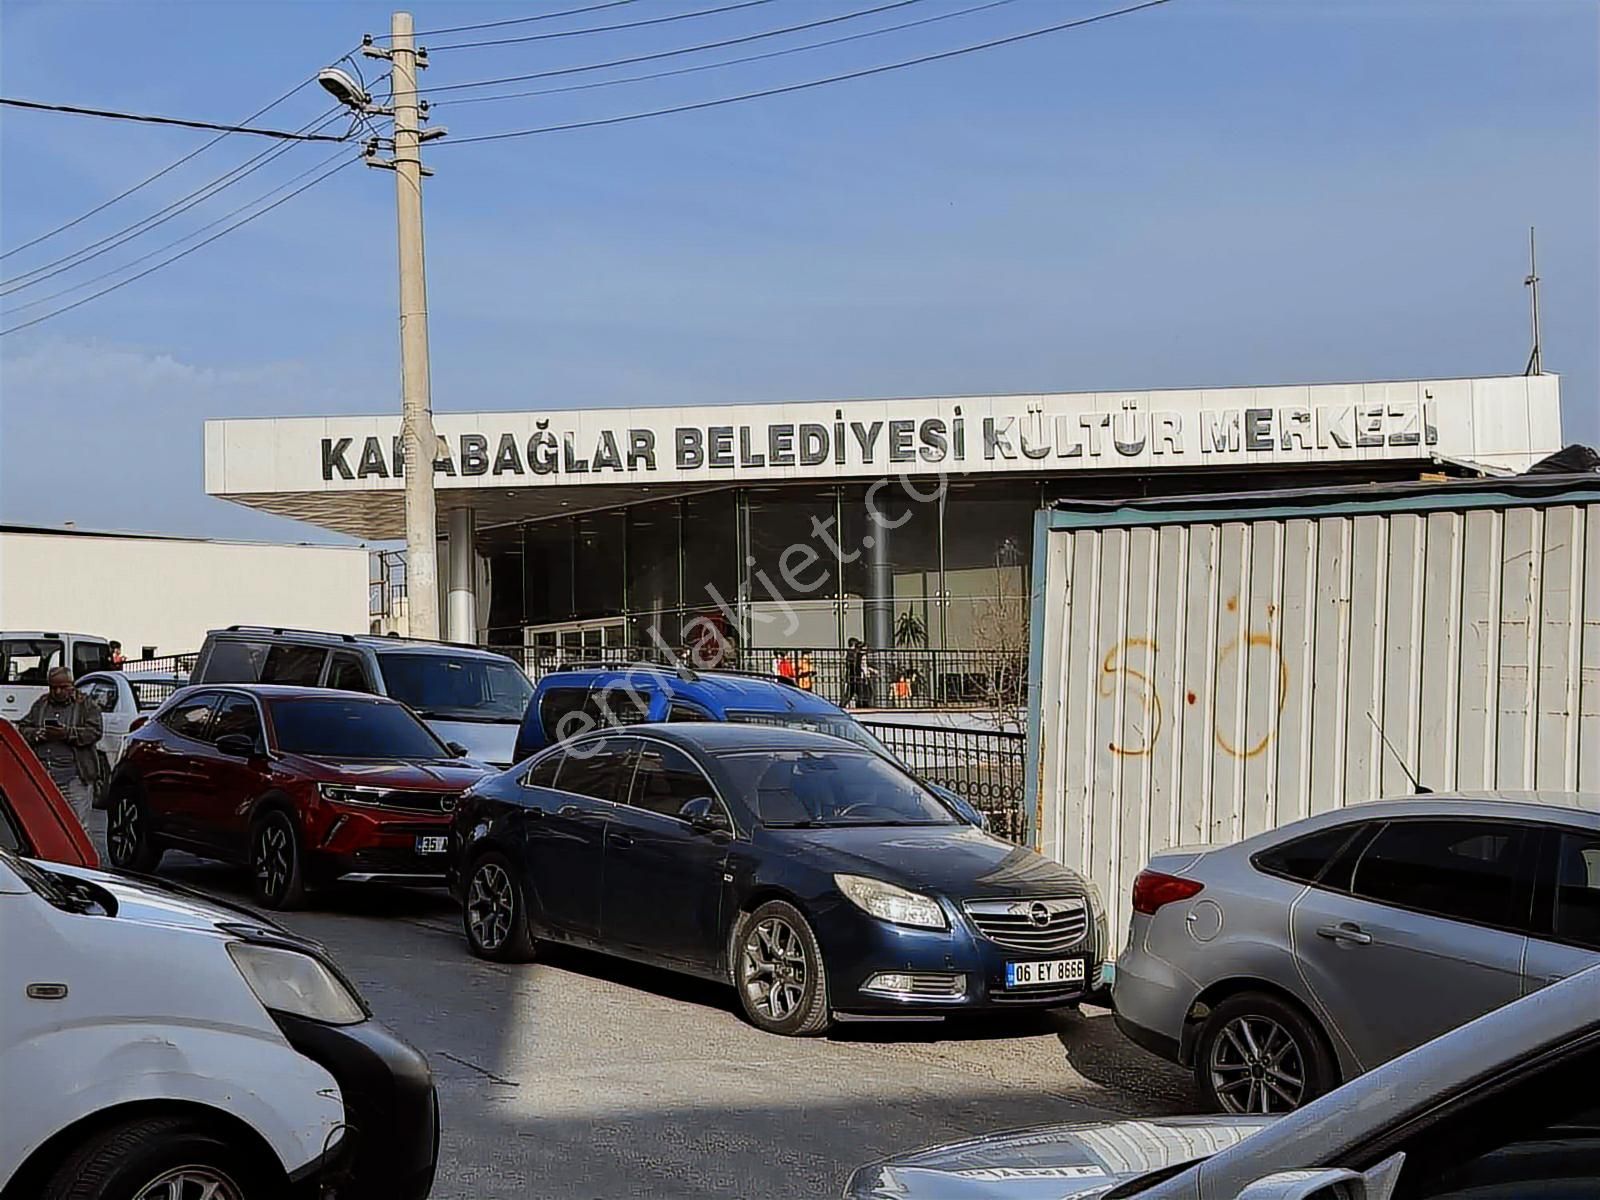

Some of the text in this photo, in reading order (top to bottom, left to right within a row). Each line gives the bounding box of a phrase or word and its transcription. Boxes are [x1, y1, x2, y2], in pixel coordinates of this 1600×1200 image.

[675, 405, 966, 470] BELEDİYESİ
[983, 400, 1185, 460] KÜLTÜR
[1200, 388, 1438, 453] MERKEZİ
[1016, 961, 1083, 982] 06 EY 8666
